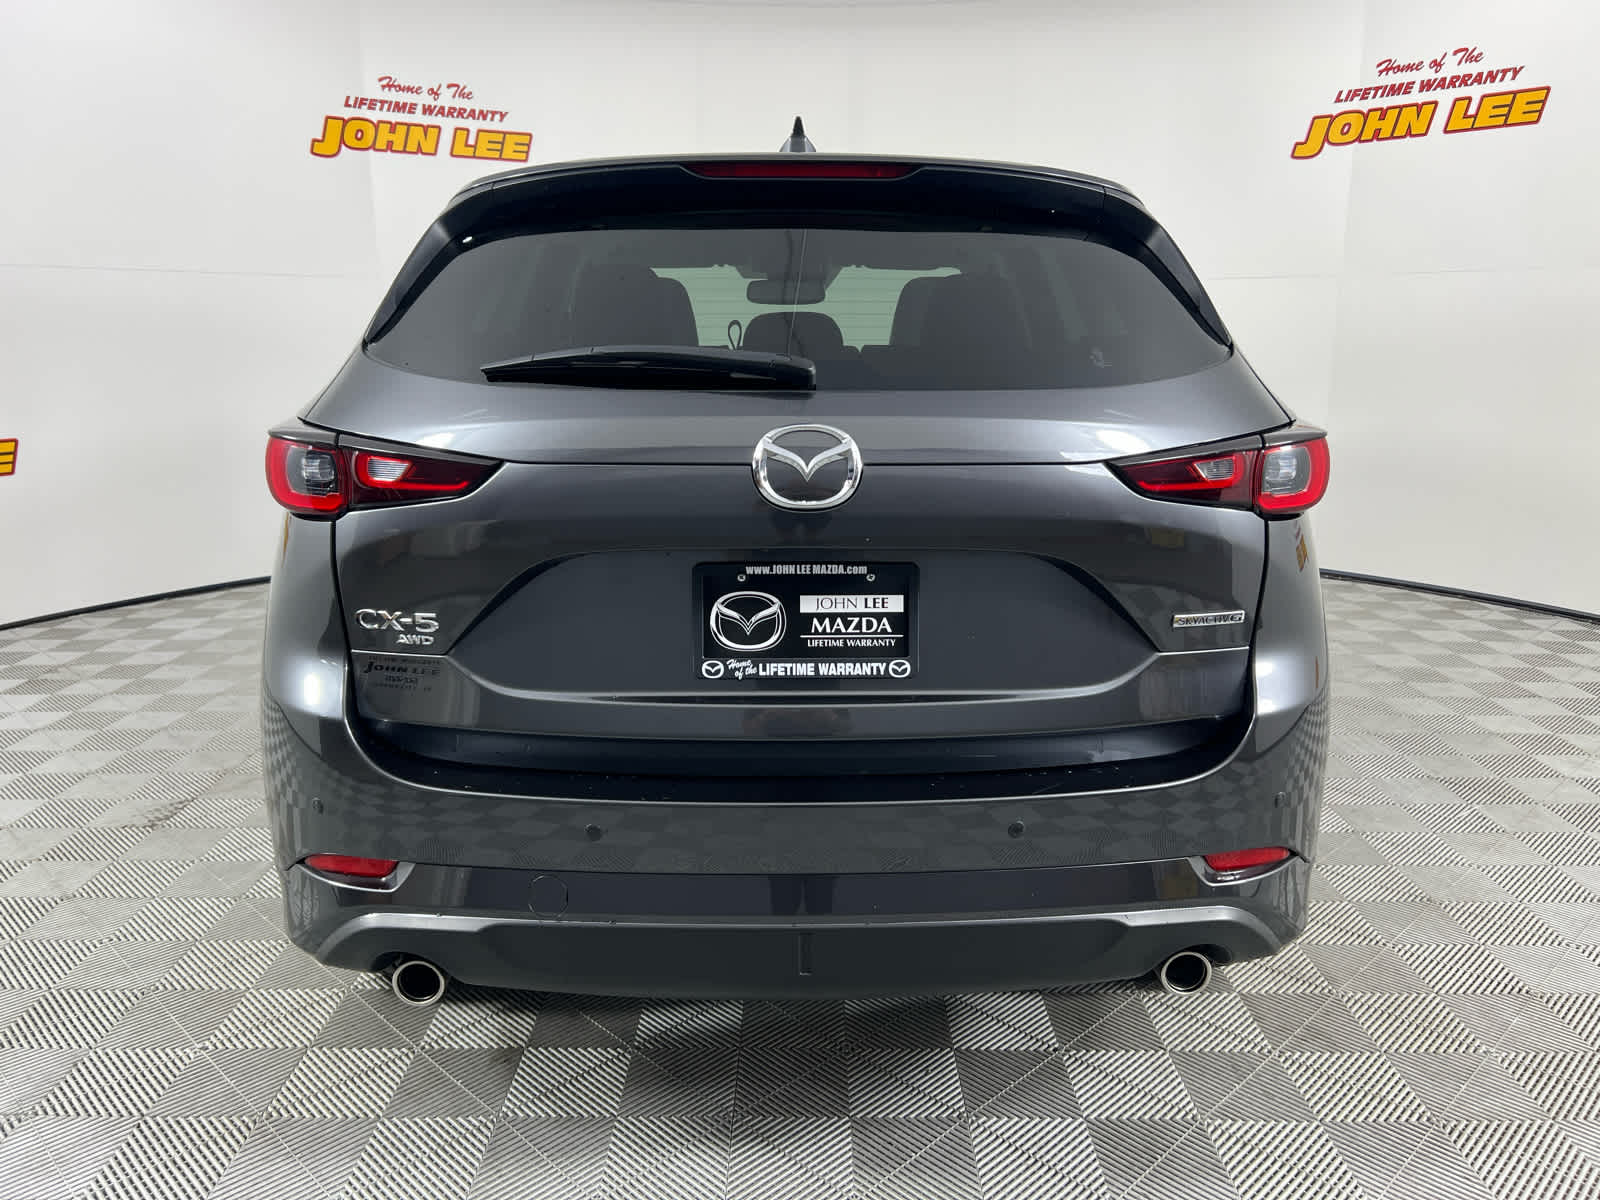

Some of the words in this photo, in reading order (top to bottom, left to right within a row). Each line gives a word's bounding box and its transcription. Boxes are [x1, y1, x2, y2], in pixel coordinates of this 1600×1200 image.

[1376, 58, 1425, 77] Home
[1429, 52, 1447, 73] of
[1452, 46, 1484, 66] The
[378, 75, 423, 96] Home
[427, 84, 442, 100] of
[446, 83, 473, 100] The
[1334, 81, 1415, 103] LIFETIME
[1418, 66, 1525, 92] WARRANTY
[344, 95, 418, 115] LIFETIME
[421, 103, 508, 122] WARRANTY
[1290, 100, 1439, 160] JOHN
[1443, 86, 1551, 134] LEE
[310, 115, 441, 158] JOHN
[450, 127, 532, 162] LEE
[815, 597, 858, 610] JOHN
[864, 597, 889, 609] LEE
[355, 608, 439, 633] CX-5
[811, 617, 892, 633] MAZDA
[396, 633, 434, 645] AWD
[807, 639, 844, 648] LIFETIME
[846, 639, 896, 648] WARRANTY
[726, 659, 751, 669] Home
[734, 669, 744, 680] of
[746, 665, 758, 675] the
[758, 663, 815, 676] LIFETIME
[818, 663, 887, 676] WARRANTY
